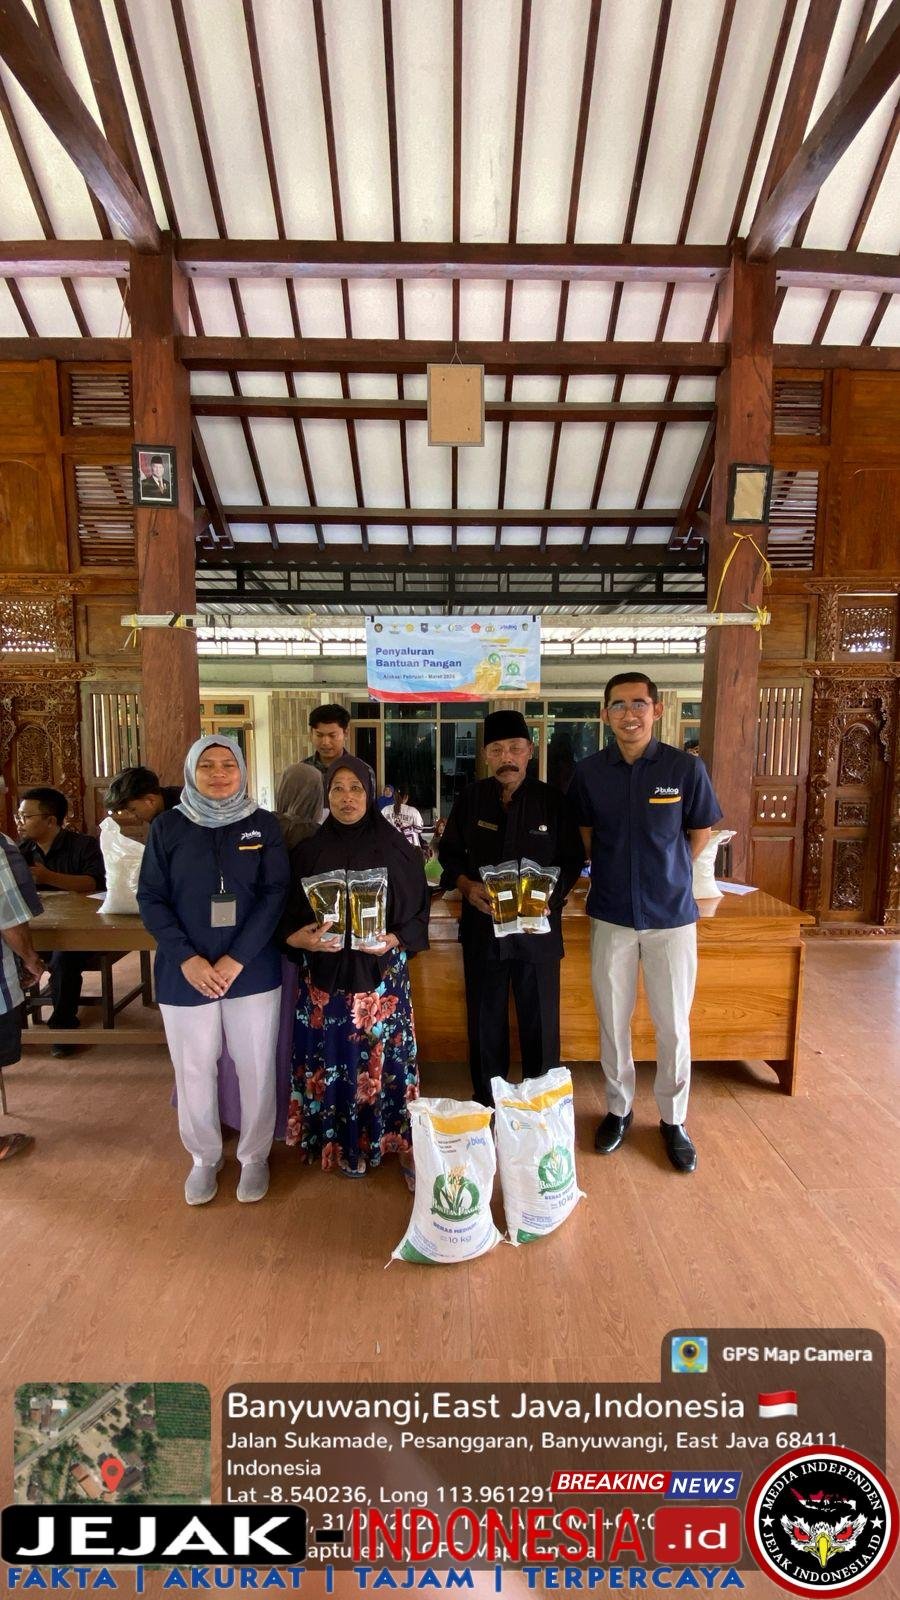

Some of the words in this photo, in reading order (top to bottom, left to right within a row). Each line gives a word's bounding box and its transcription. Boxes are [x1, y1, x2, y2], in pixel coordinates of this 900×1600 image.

[375, 647, 435, 657] Penyaluran
[375, 659, 420, 668] Bantuan
[423, 659, 462, 669] Pangan
[659, 787, 679, 795] bulog
